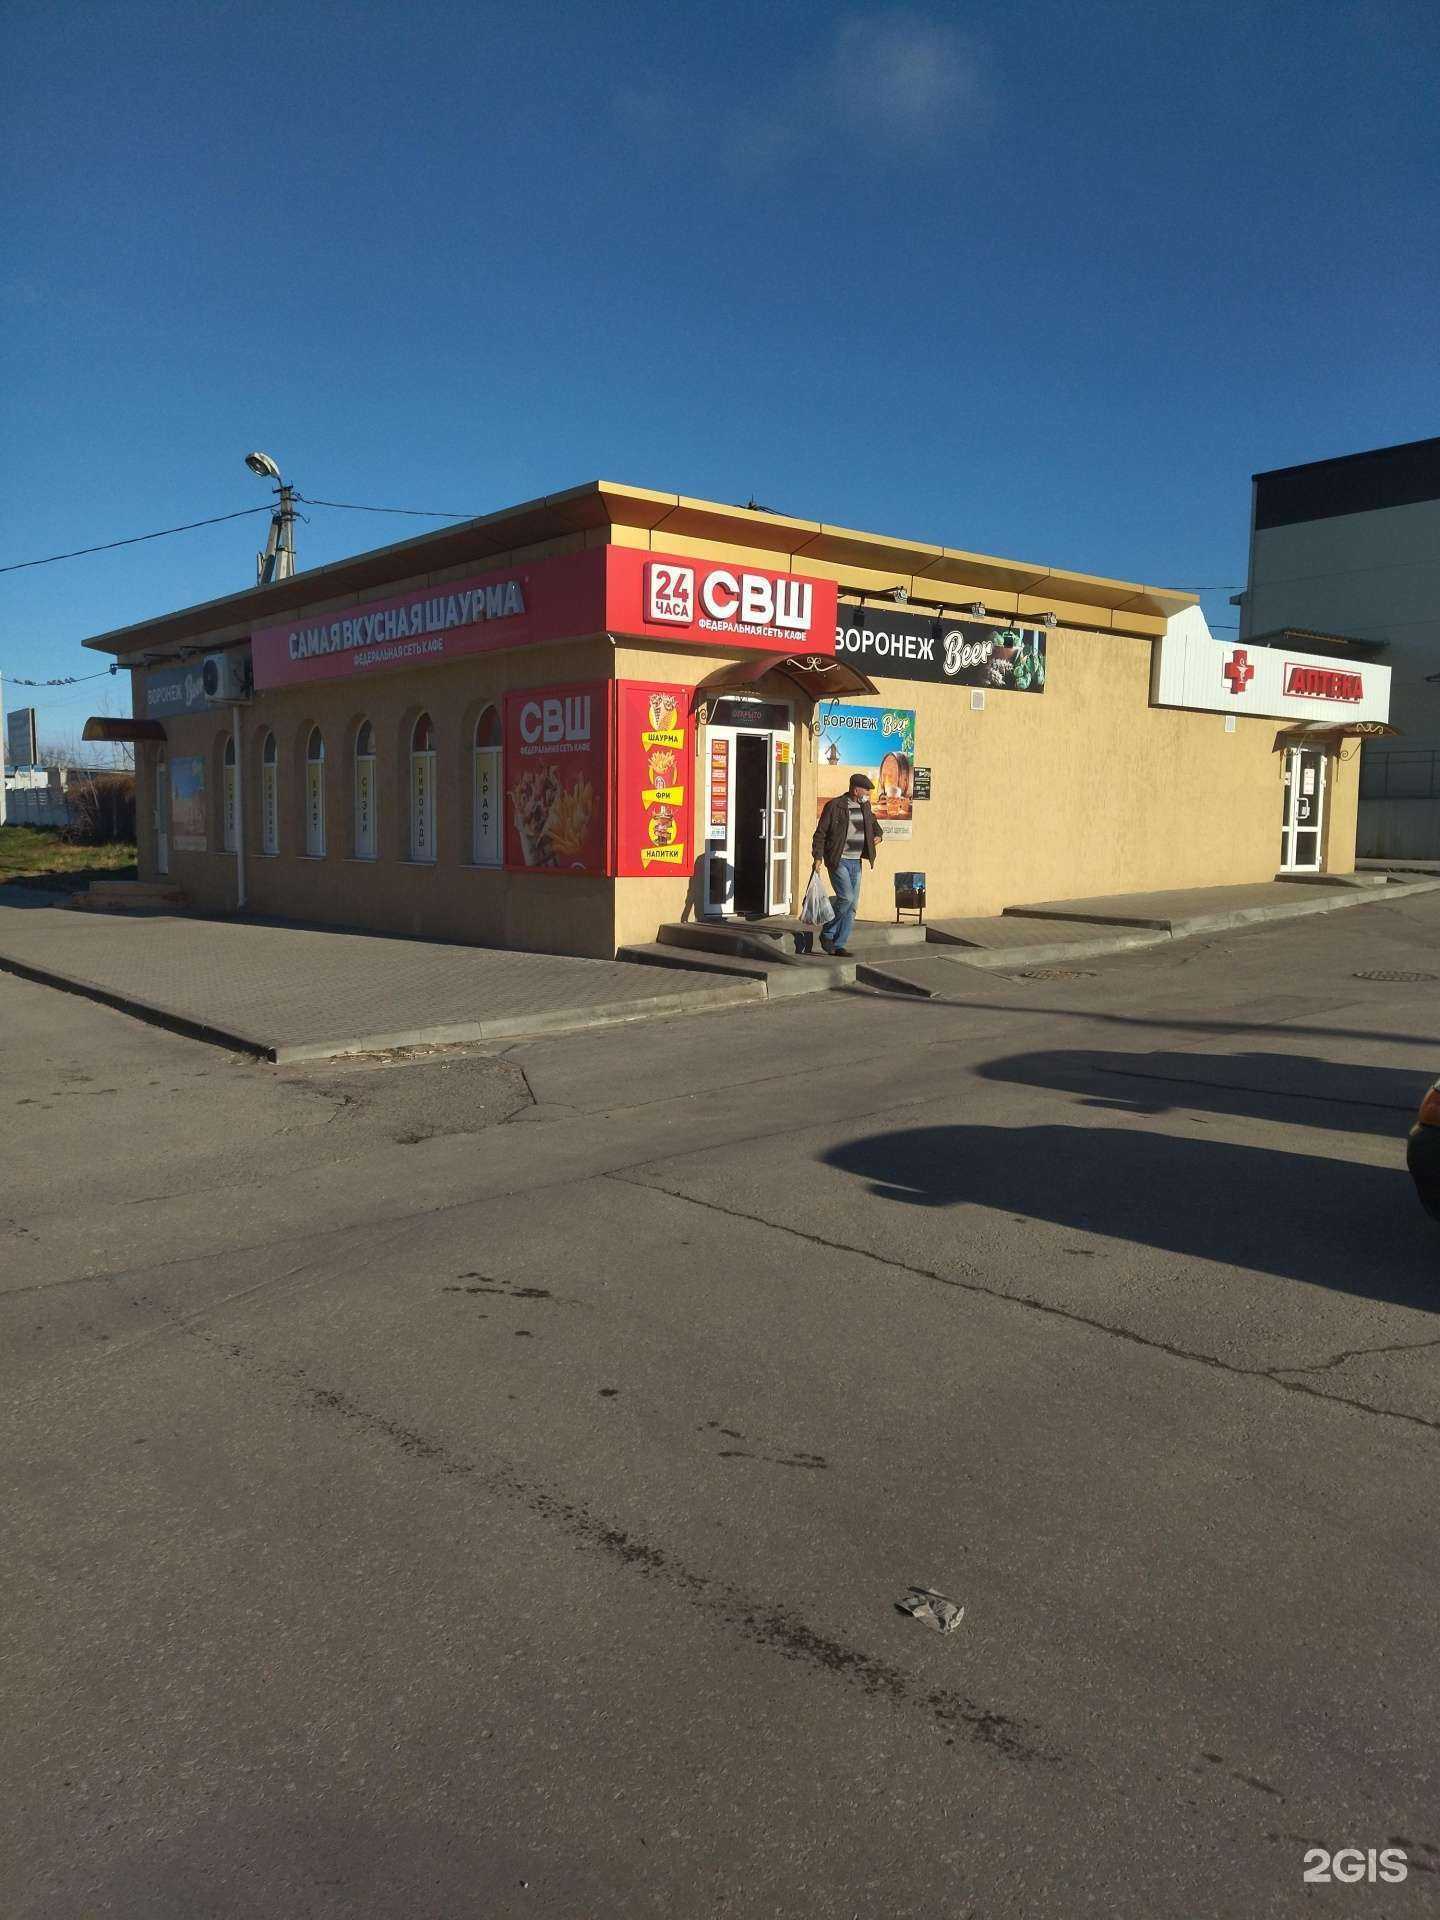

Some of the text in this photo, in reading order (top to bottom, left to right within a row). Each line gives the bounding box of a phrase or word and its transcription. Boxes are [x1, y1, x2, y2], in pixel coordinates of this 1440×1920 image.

[656, 570, 689, 602] 24
[701, 569, 812, 630] СВШ
[288, 581, 525, 660] САМАЯ ВКУСНАЯ ШАУРМА
[656, 601, 689, 617] ЧАСА
[698, 618, 807, 641] ФЕДЕРАЛЬНАЯ СЕТЬ КАФЕ
[942, 630, 992, 676] Beer
[520, 695, 591, 743] СВШ
[823, 714, 908, 736] ВОРОНЕЖ Beer
[648, 735, 678, 743] ШАУРМА
[646, 850, 679, 858] НАПИТКИ
